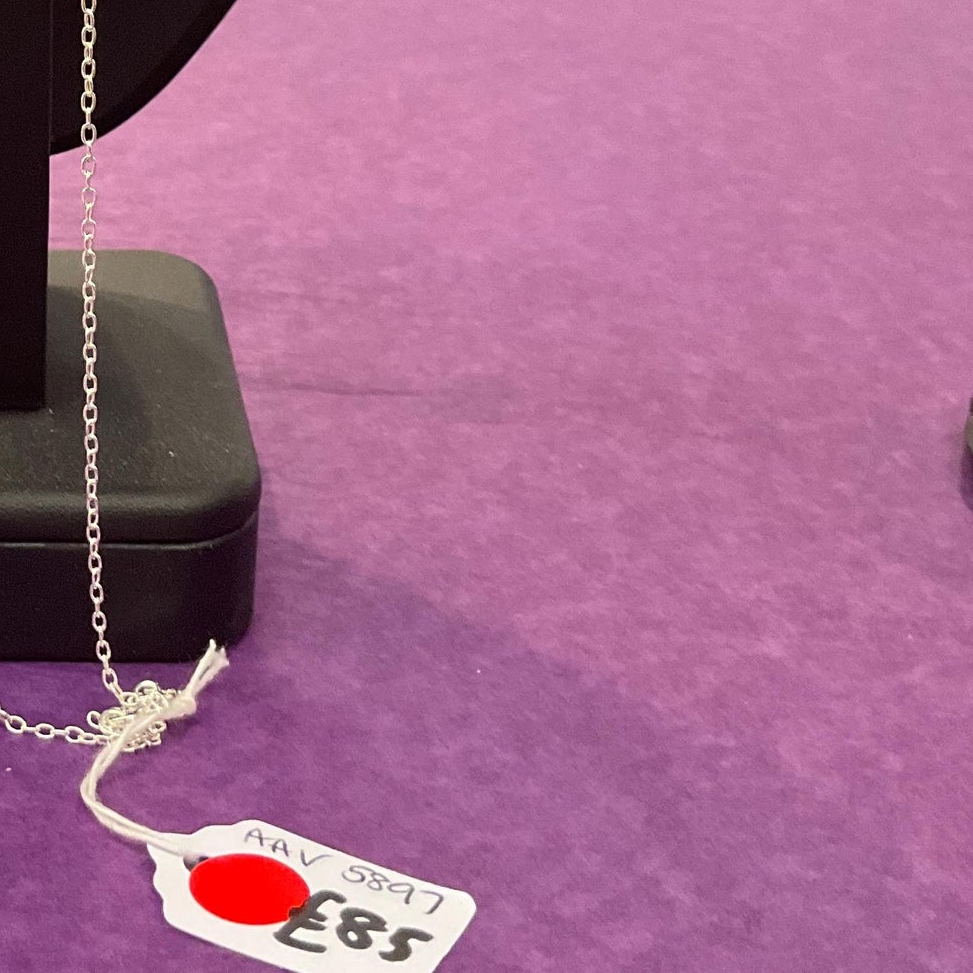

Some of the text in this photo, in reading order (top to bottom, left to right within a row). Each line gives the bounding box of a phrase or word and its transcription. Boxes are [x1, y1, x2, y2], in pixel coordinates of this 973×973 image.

[243, 827, 445, 915] AAV 5897
[273, 889, 434, 963] £85
